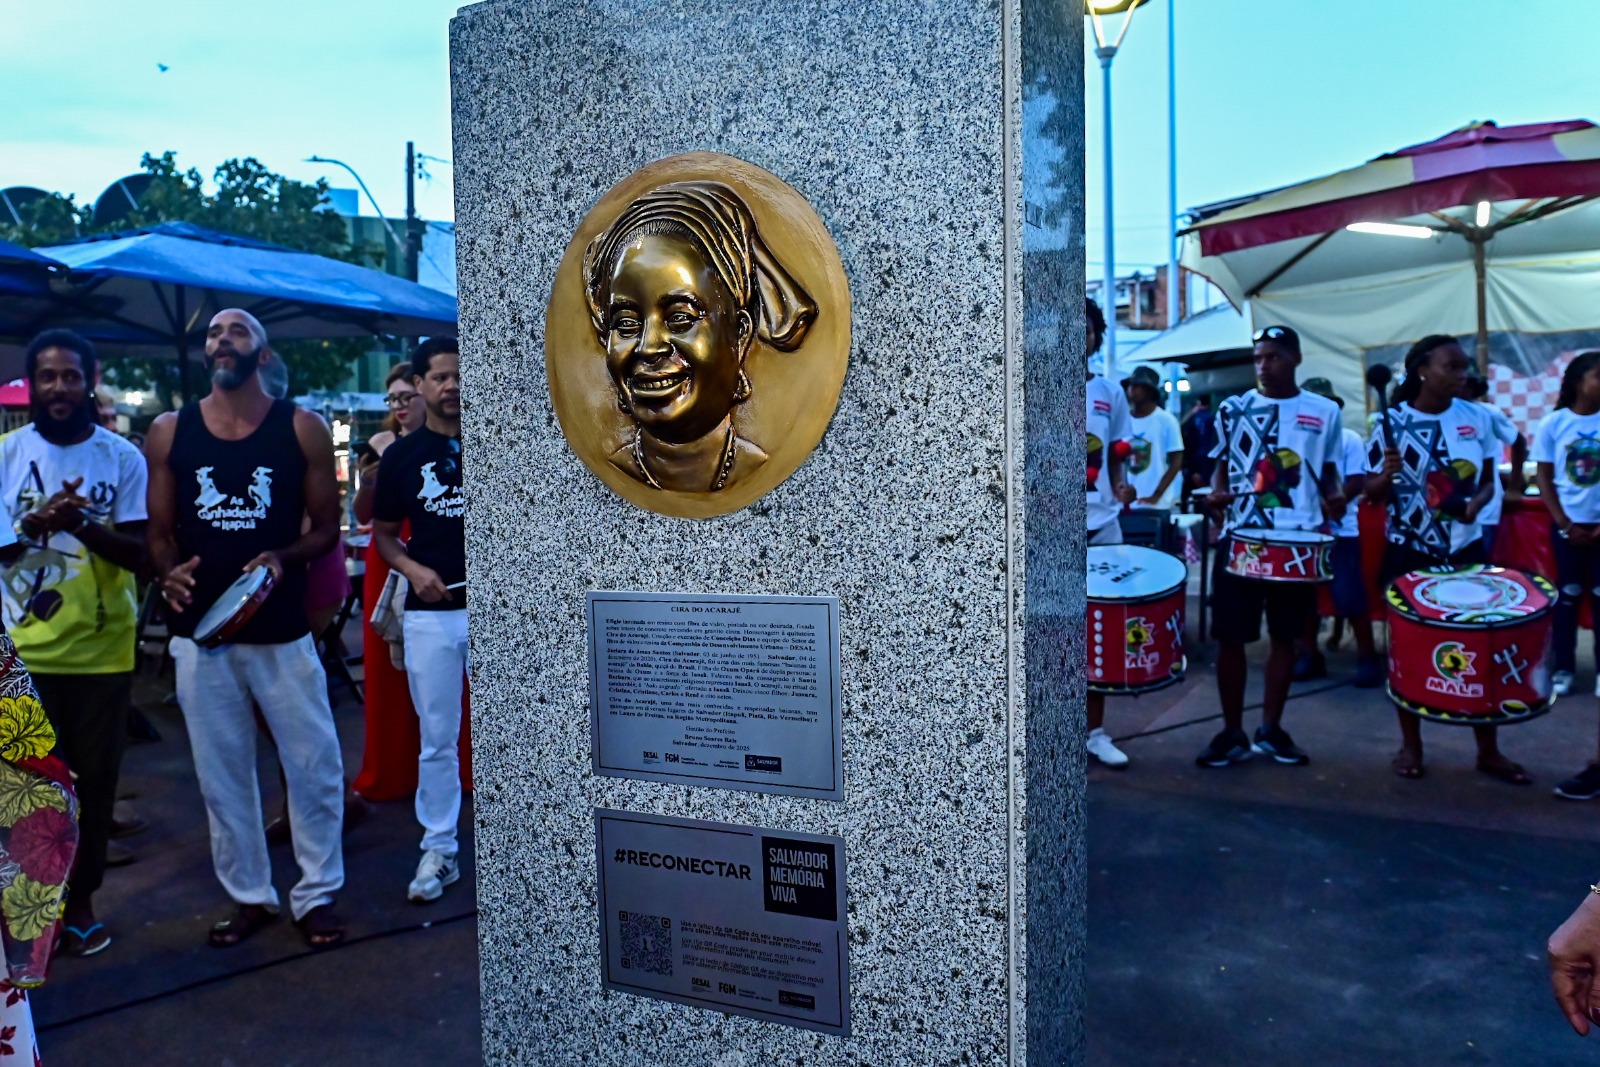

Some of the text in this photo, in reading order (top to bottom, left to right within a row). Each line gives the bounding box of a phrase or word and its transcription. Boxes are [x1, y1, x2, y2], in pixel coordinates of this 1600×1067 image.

[230, 496, 244, 505] As
[665, 753, 680, 763] FGM
[614, 848, 752, 881] #RECONECTAR
[769, 847, 829, 870] SALVADOR
[770, 863, 826, 890] MEMÓRIA
[771, 884, 798, 904] VIVA
[719, 982, 737, 996] FGM
